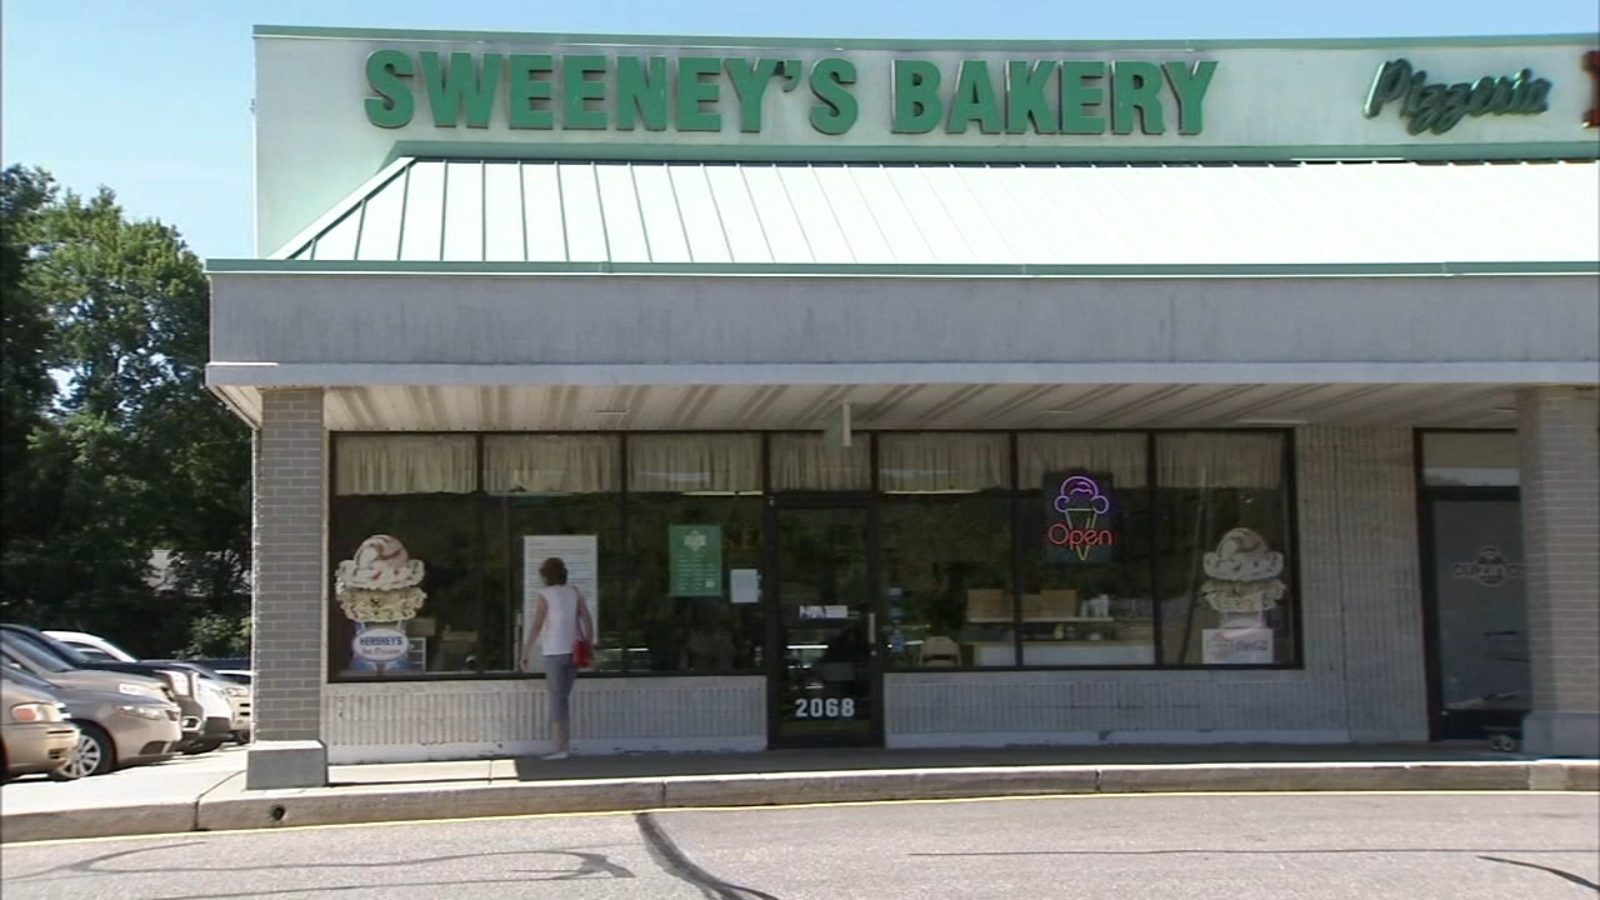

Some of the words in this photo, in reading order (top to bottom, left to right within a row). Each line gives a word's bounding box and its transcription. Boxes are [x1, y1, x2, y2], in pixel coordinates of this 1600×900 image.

[365, 49, 859, 136] SWEENEY'S
[889, 59, 1220, 136] BAKERY
[1363, 58, 1552, 136] Pizzeria
[1048, 523, 1113, 551] Open
[795, 697, 855, 718] 2068
